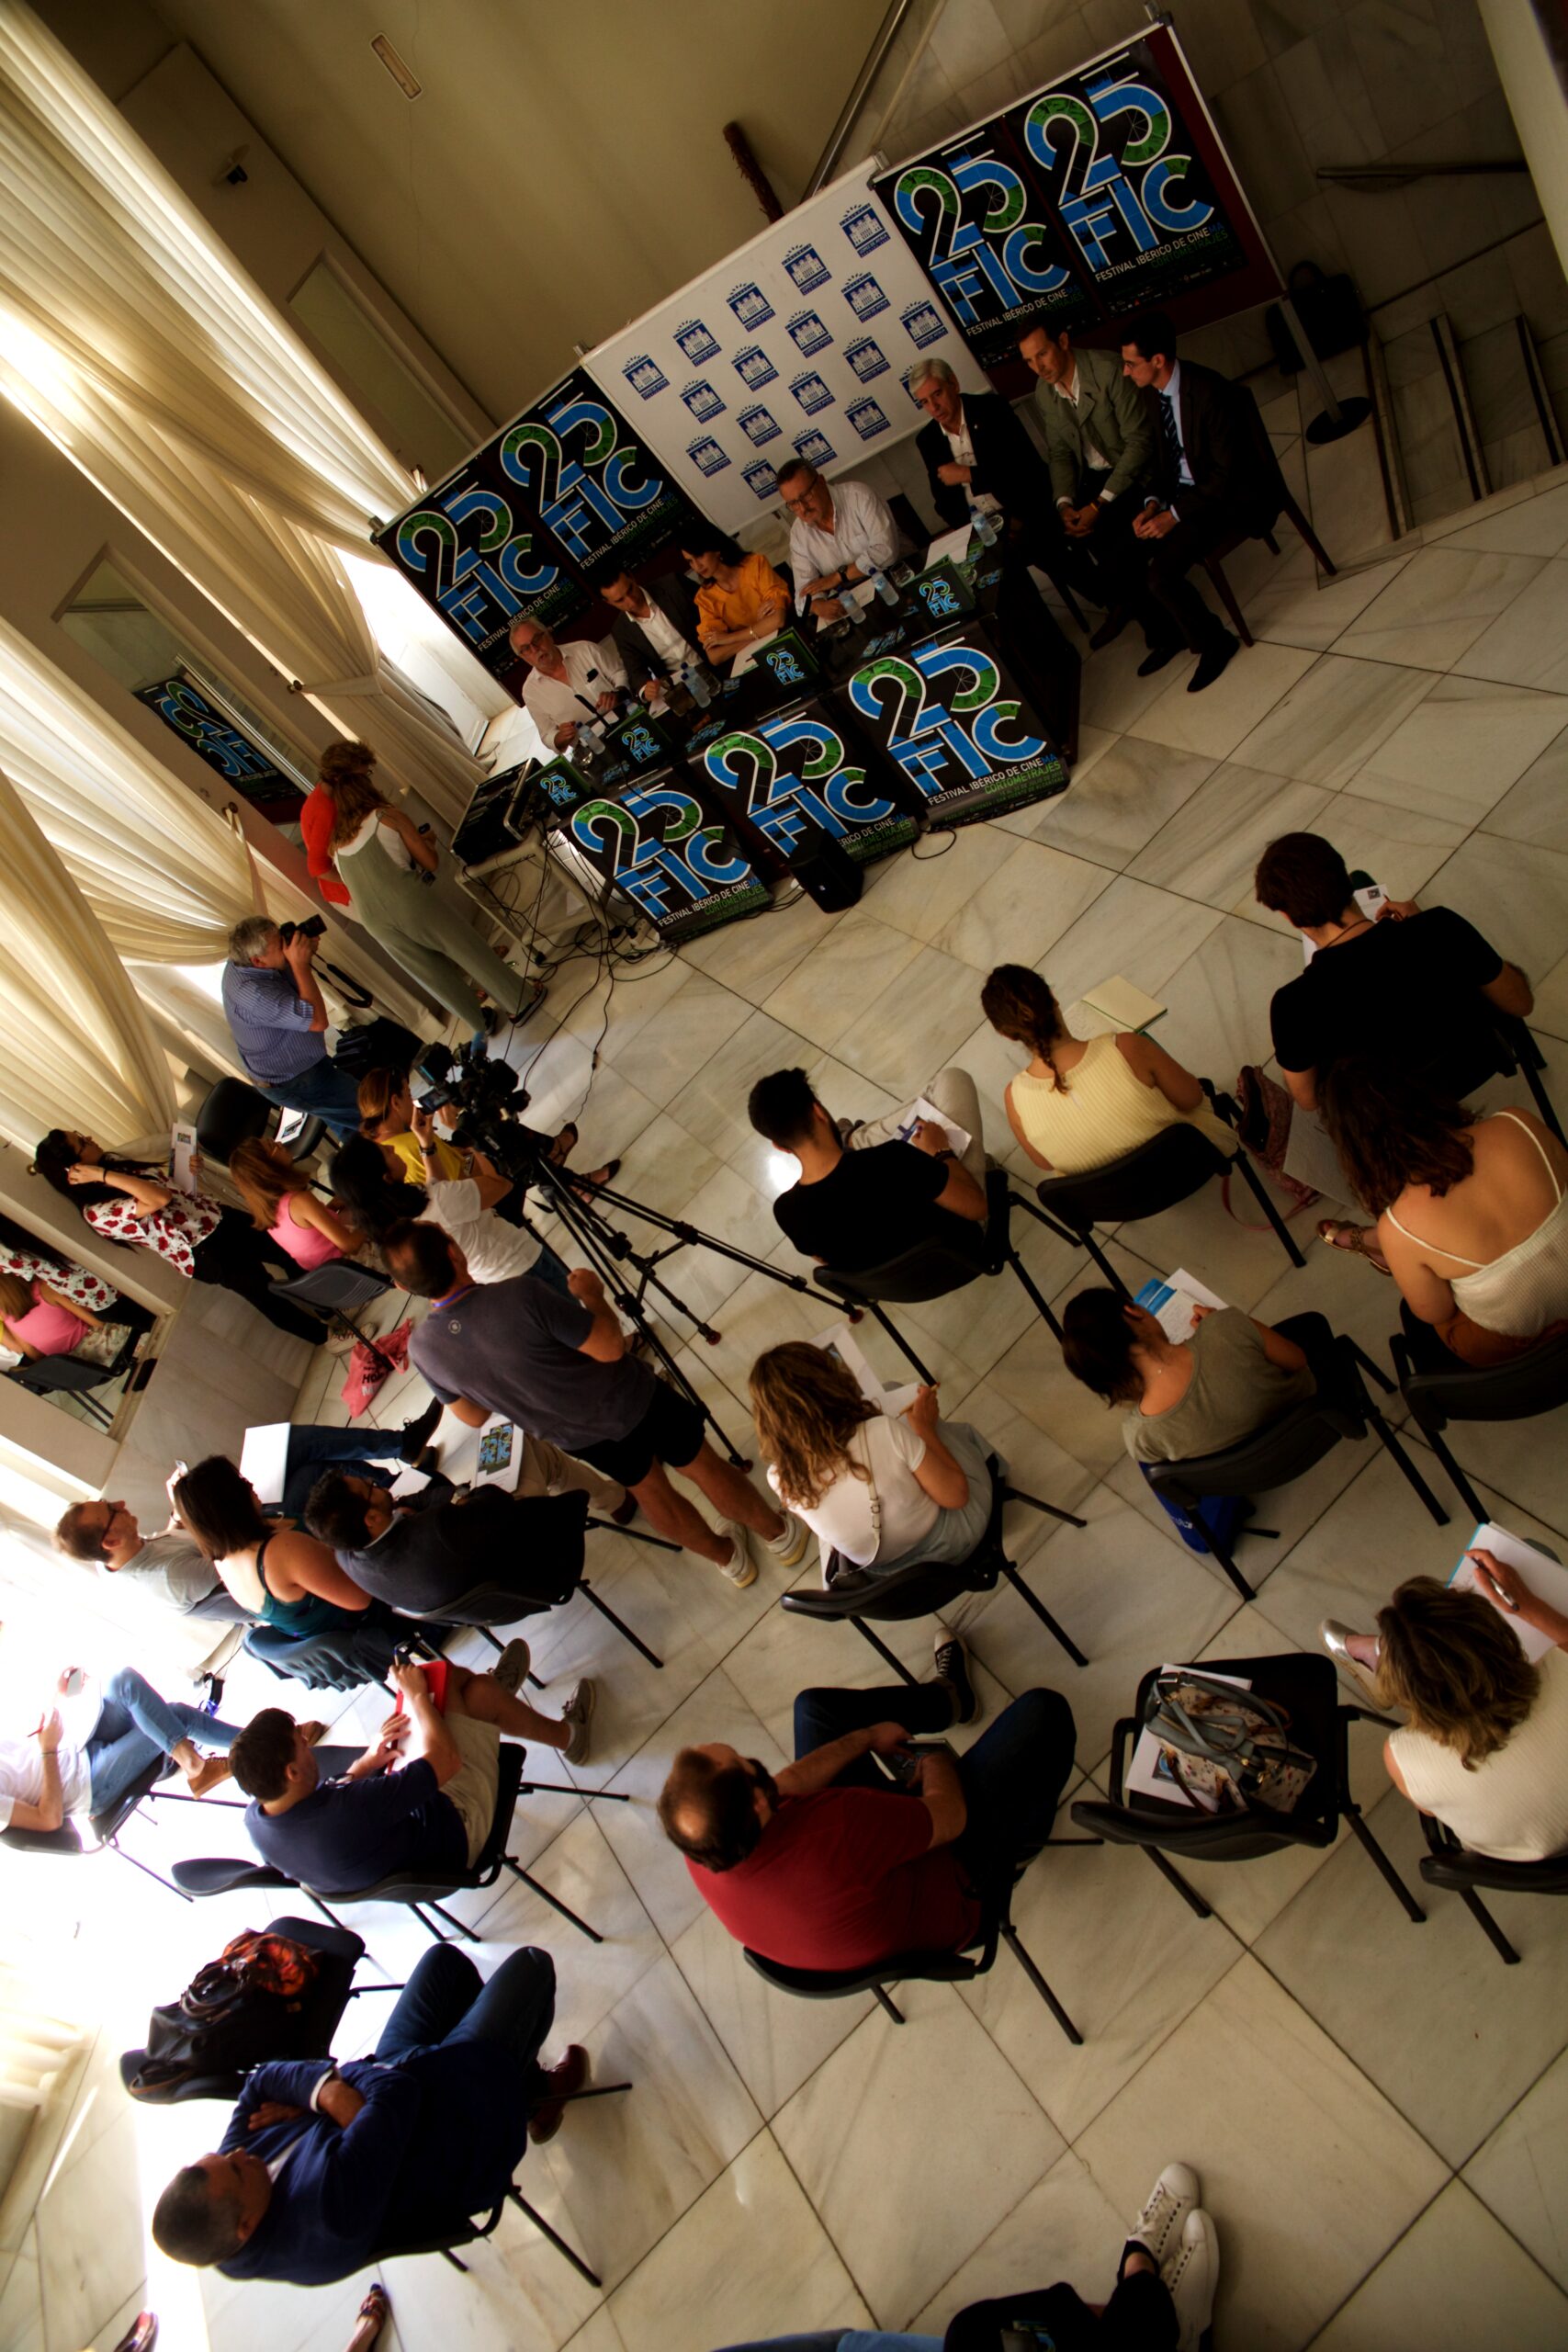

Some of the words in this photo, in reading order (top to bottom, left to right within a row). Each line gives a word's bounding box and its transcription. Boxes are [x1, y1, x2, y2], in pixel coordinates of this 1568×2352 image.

[1024, 51, 1172, 206] 25
[894, 131, 1027, 266] 25
[1094, 258, 1136, 283] FESTIVAL
[1134, 241, 1172, 266] IBÉRICO
[1171, 236, 1187, 250] DE
[1150, 228, 1229, 269] CORTOMETRAJES
[965, 315, 1003, 337] FESTIVAL
[1001, 300, 1034, 322] IBÉRICO
[1033, 296, 1047, 308] DE
[500, 379, 617, 514] 25
[396, 469, 513, 598] 25
[579, 541, 613, 571] FESTIVAL
[609, 519, 637, 545] IBÉRICO
[636, 511, 648, 524] DE
[476, 624, 509, 652] FESTIVAL
[532, 595, 544, 607] DE
[848, 622, 1000, 748] 25
[705, 698, 845, 815] 25
[983, 760, 1061, 795] CORTOMETRAJES
[927, 784, 969, 807] FESTIVAL
[968, 769, 1005, 791] IBÉRICO
[1005, 765, 1019, 777] DE
[571, 769, 703, 877] 25
[837, 830, 861, 848] RICO
[861, 825, 874, 838] DE
[657, 906, 691, 927] FESTIVAL
[691, 892, 720, 912] IBÉRICO
[720, 888, 731, 899] DE
[704, 883, 764, 915] CORTOMETRAJES
